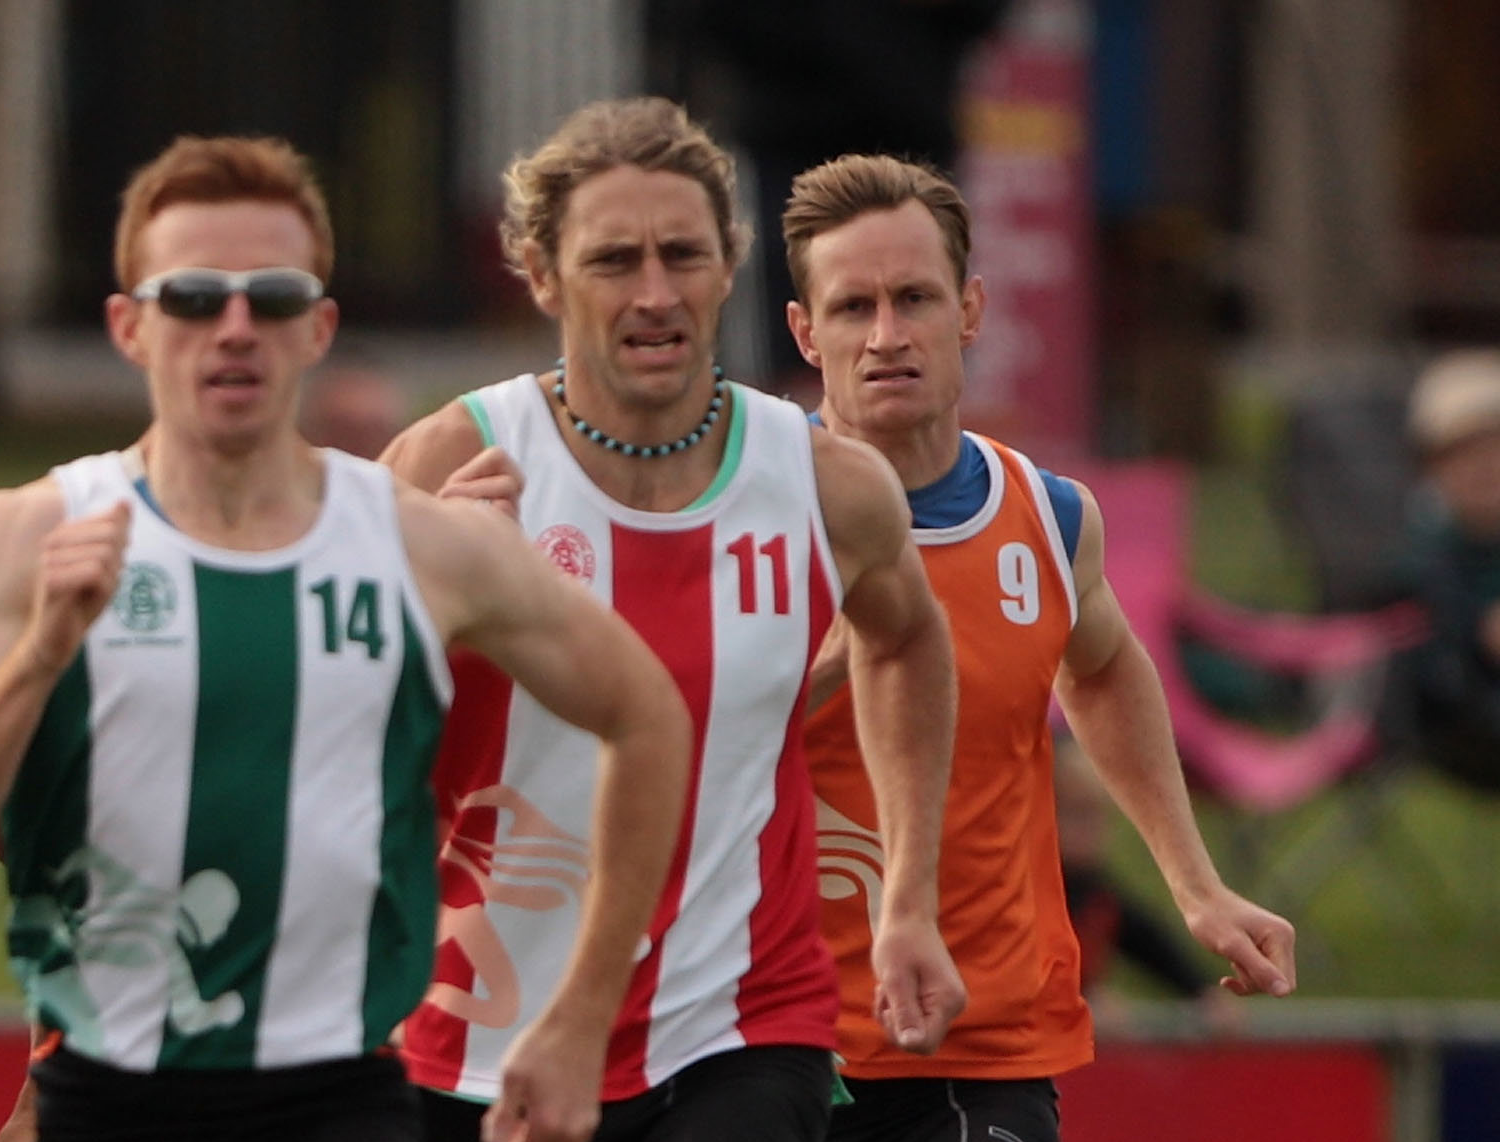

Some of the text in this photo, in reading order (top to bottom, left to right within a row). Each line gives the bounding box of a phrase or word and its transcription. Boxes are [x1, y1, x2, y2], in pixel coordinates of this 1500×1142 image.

[726, 532, 790, 614] 11
[998, 542, 1039, 624] 9
[310, 576, 385, 659] 14
